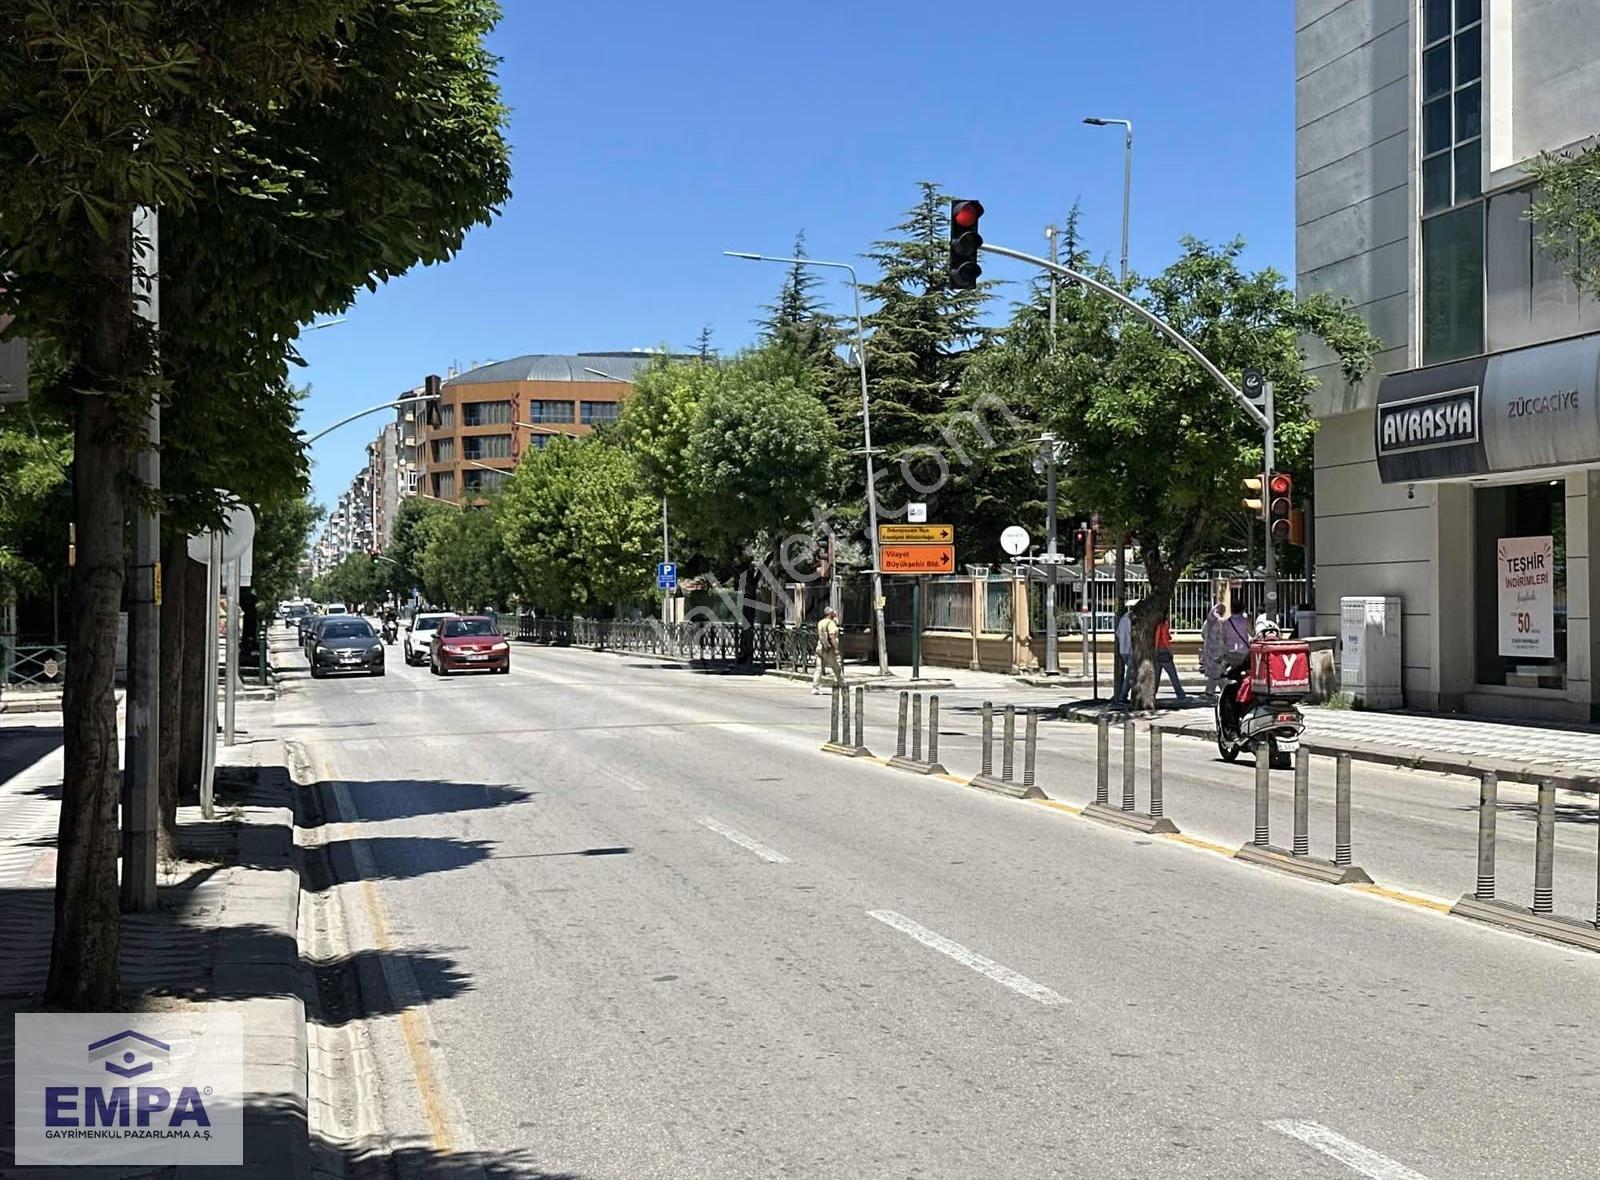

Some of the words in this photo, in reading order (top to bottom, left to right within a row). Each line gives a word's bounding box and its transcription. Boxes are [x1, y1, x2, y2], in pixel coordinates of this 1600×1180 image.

[1383, 401, 1472, 446] AVRASYA
[885, 551, 910, 559] Vilayet
[1507, 551, 1545, 573] TEŞHİR
[1505, 570, 1549, 589] İNDİRİMLERİ
[1517, 611, 1531, 633] 50
